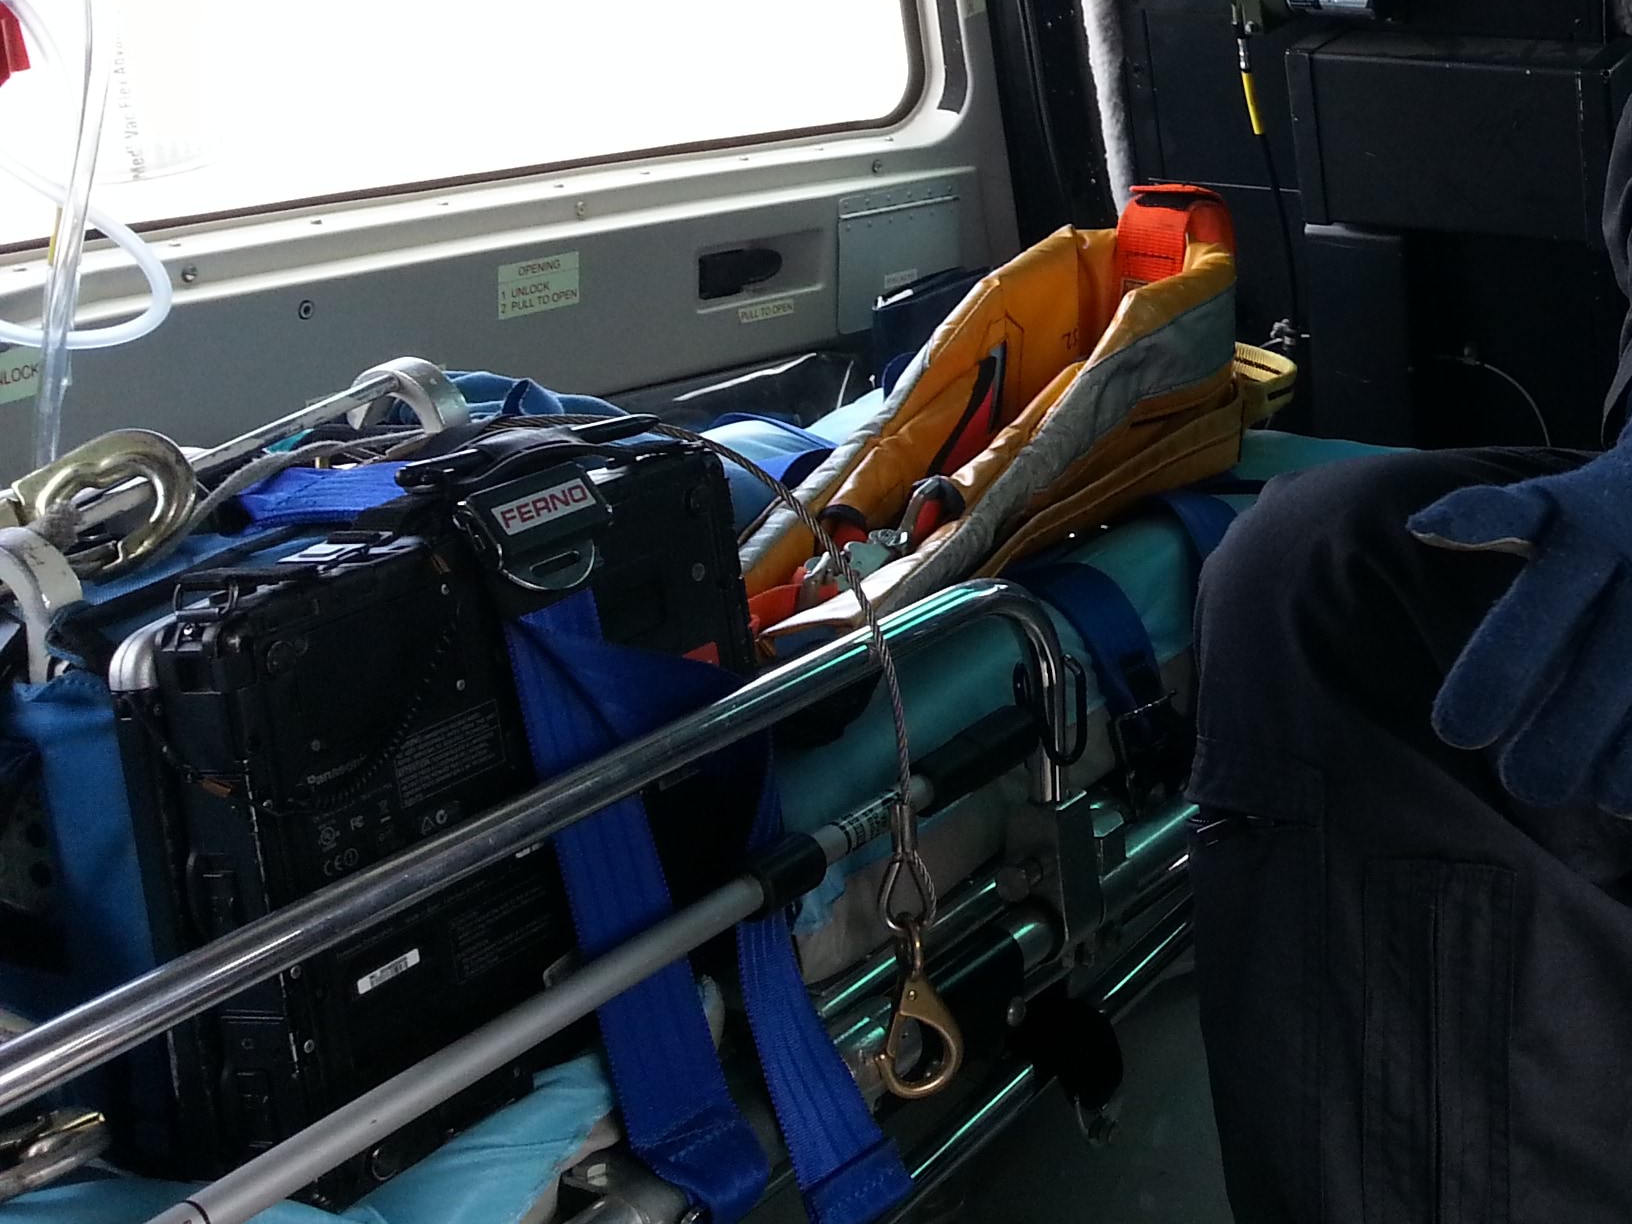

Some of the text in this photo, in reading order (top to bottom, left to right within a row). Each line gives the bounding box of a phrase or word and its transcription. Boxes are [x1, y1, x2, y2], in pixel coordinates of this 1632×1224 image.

[518, 259, 562, 276] OPENING
[511, 281, 550, 299] UNLOCK
[511, 298, 535, 312] PULL
[537, 294, 551, 305] TO
[551, 288, 578, 303] OPEN
[0, 362, 39, 385] LOCK
[500, 484, 588, 529] FERNO
